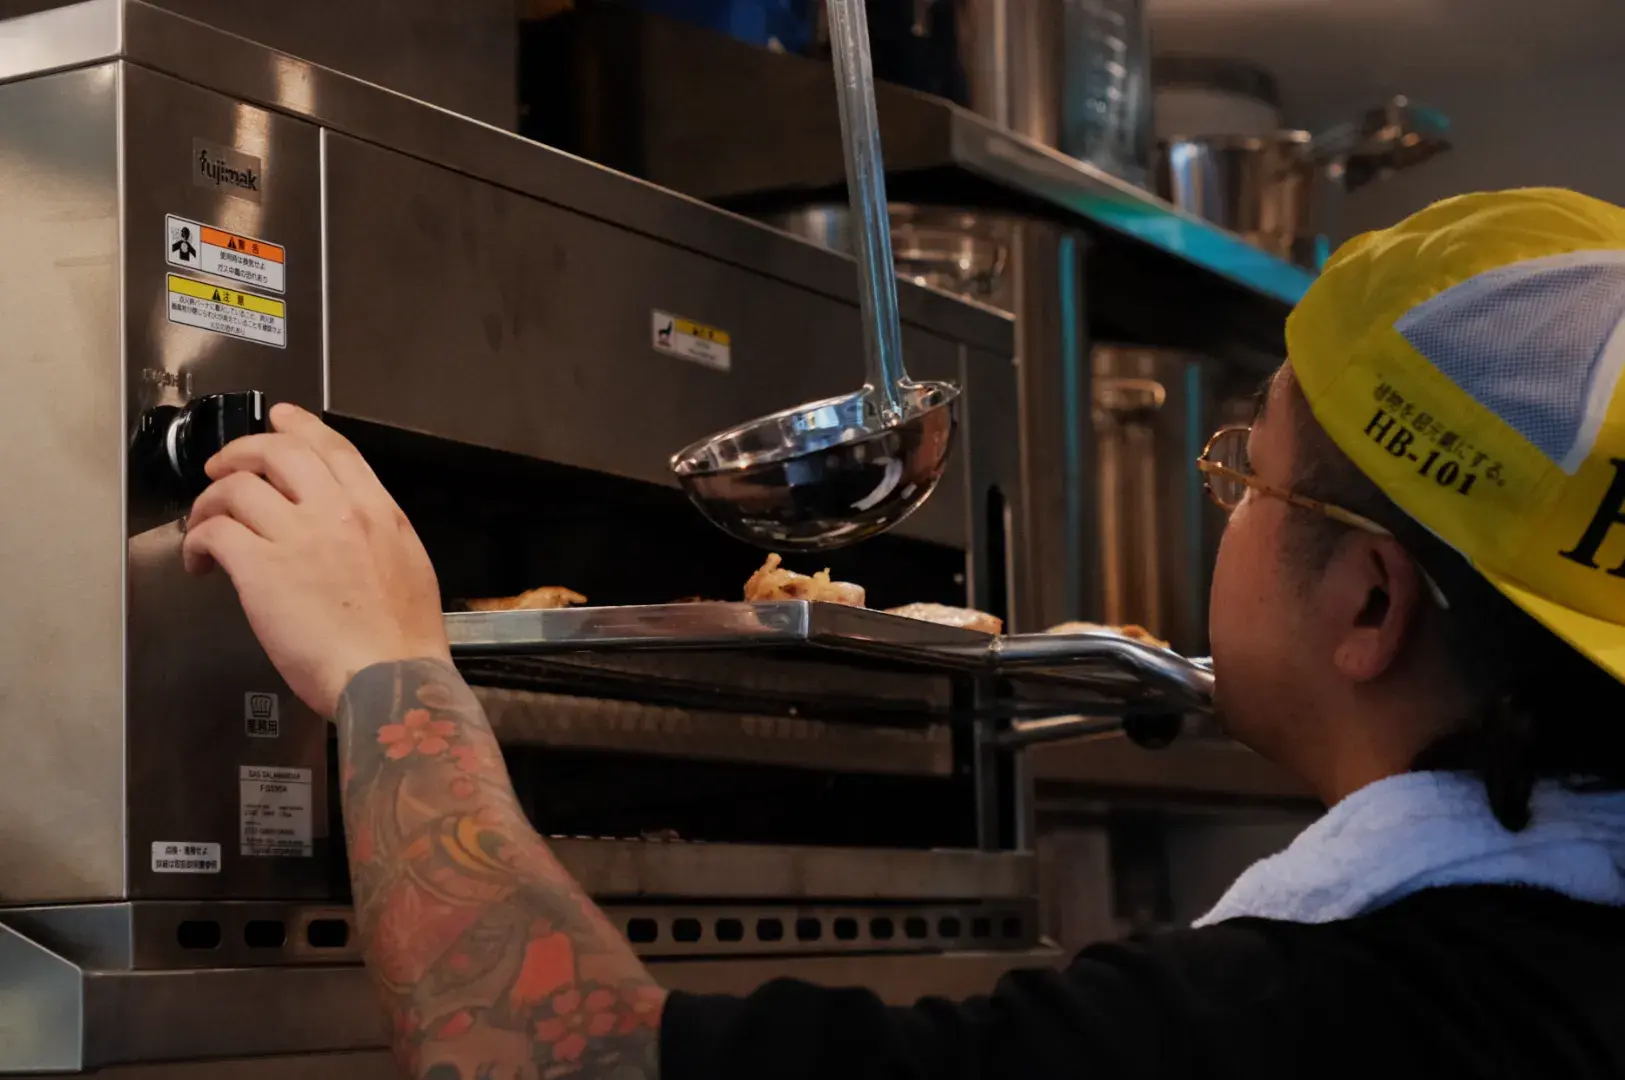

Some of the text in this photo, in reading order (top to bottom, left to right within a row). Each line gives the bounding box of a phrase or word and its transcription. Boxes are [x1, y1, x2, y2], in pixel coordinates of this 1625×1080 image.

[199, 149, 258, 191] fujimak
[222, 290, 245, 306] 注意
[1363, 409, 1477, 496] HB-101
